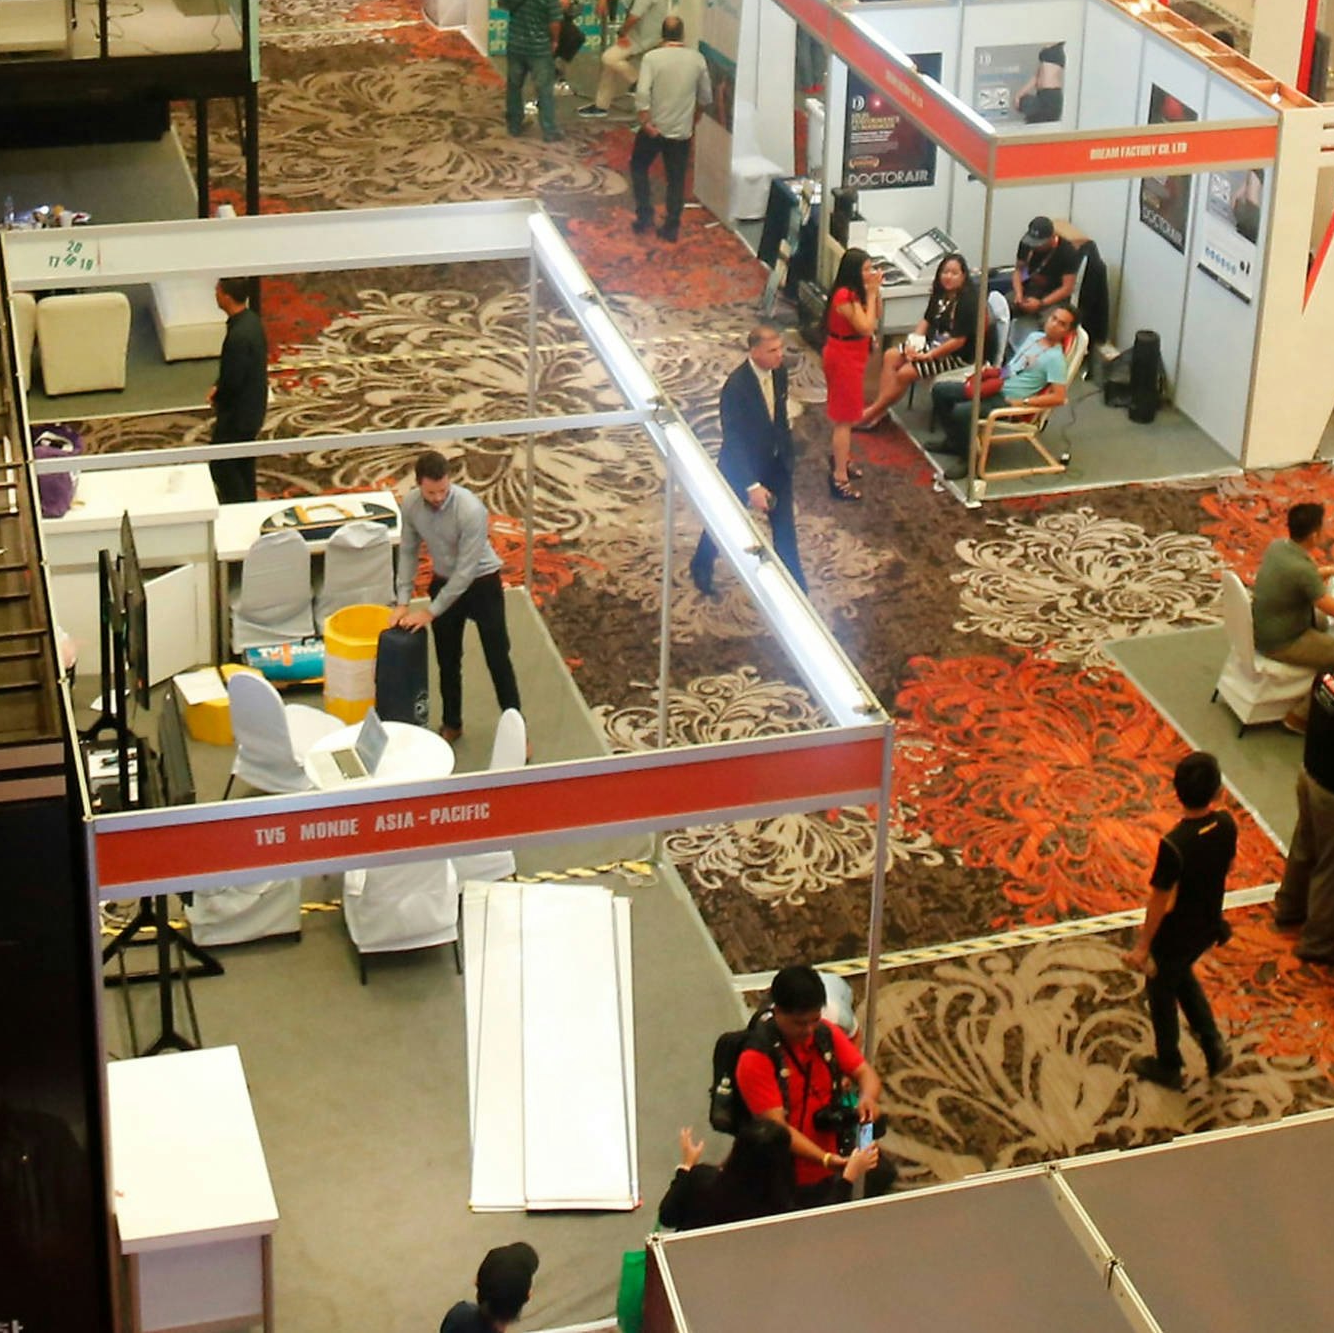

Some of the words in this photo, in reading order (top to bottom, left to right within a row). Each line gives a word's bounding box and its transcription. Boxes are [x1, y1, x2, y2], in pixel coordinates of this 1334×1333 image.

[1090, 148, 1119, 160] DREAM
[1121, 145, 1156, 158] FACTORY
[1172, 142, 1187, 154] LTD
[848, 169, 929, 186] DOCTORAIR
[255, 826, 286, 846] TV5
[300, 818, 359, 841] MONDE
